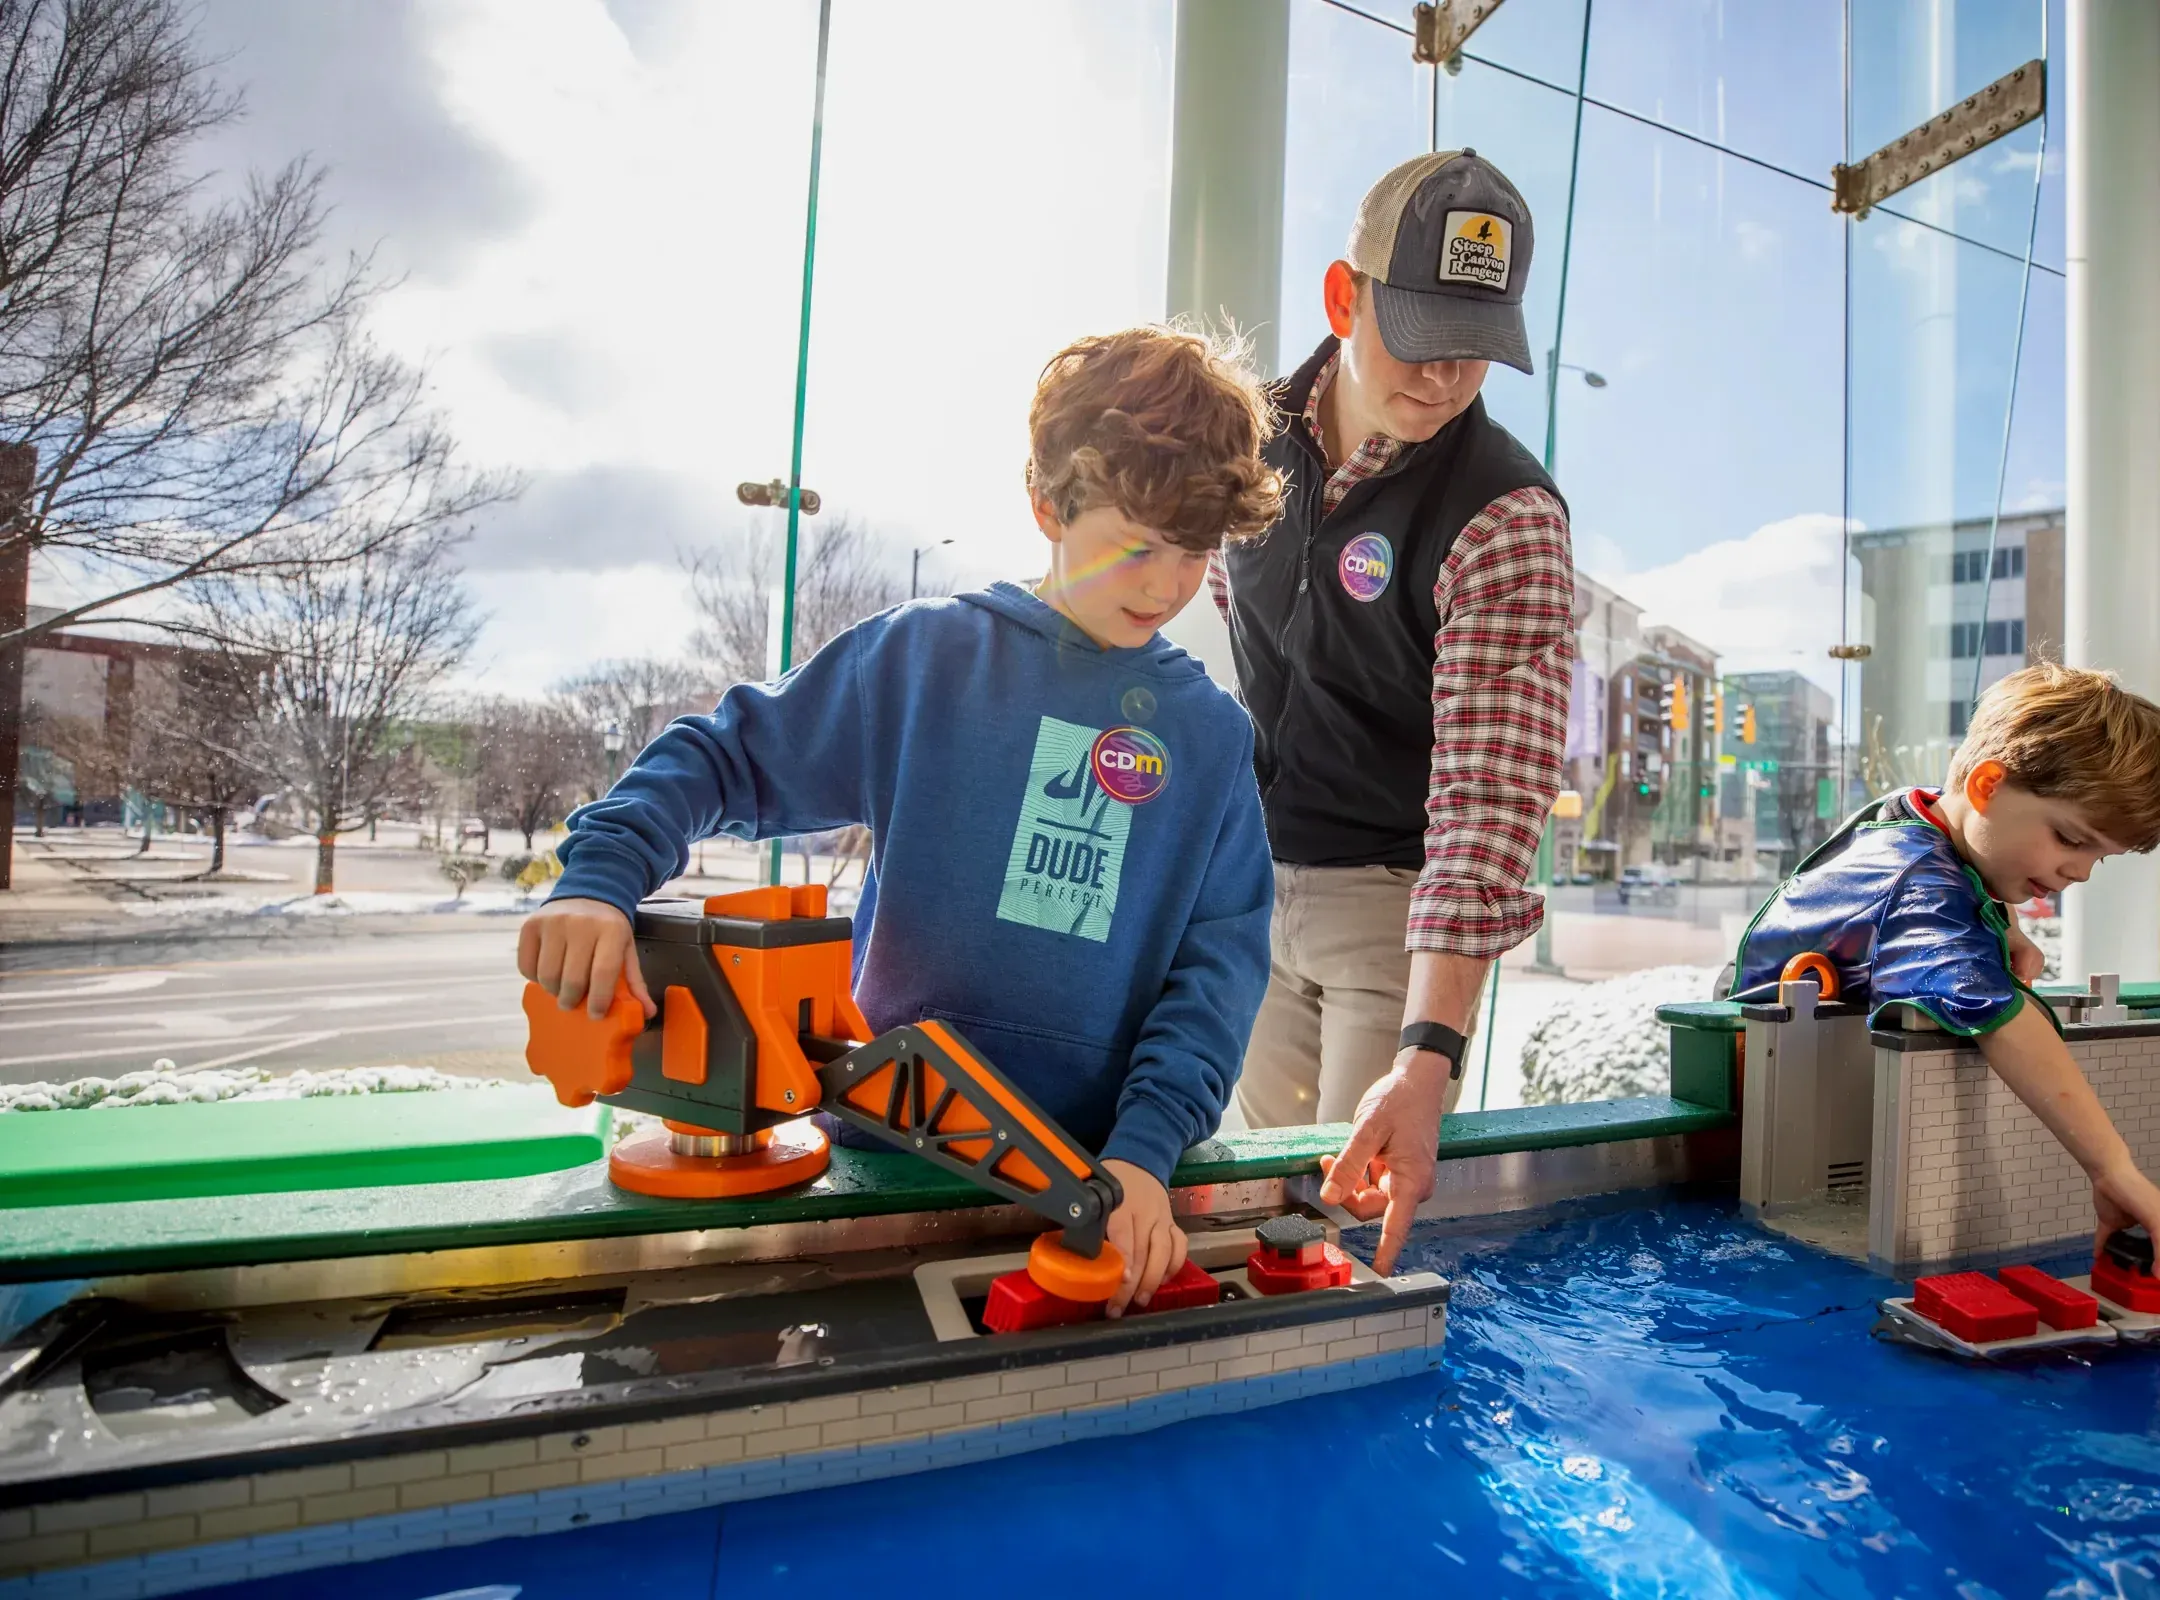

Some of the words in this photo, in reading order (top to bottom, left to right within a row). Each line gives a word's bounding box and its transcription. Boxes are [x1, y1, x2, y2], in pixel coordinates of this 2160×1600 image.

[1451, 238, 1494, 257] Steep
[1450, 260, 1501, 281] Rangers
[1460, 251, 1504, 271] Canyon
[1025, 832, 1109, 889] DUDE
[1020, 878, 1101, 908] PERFECT
